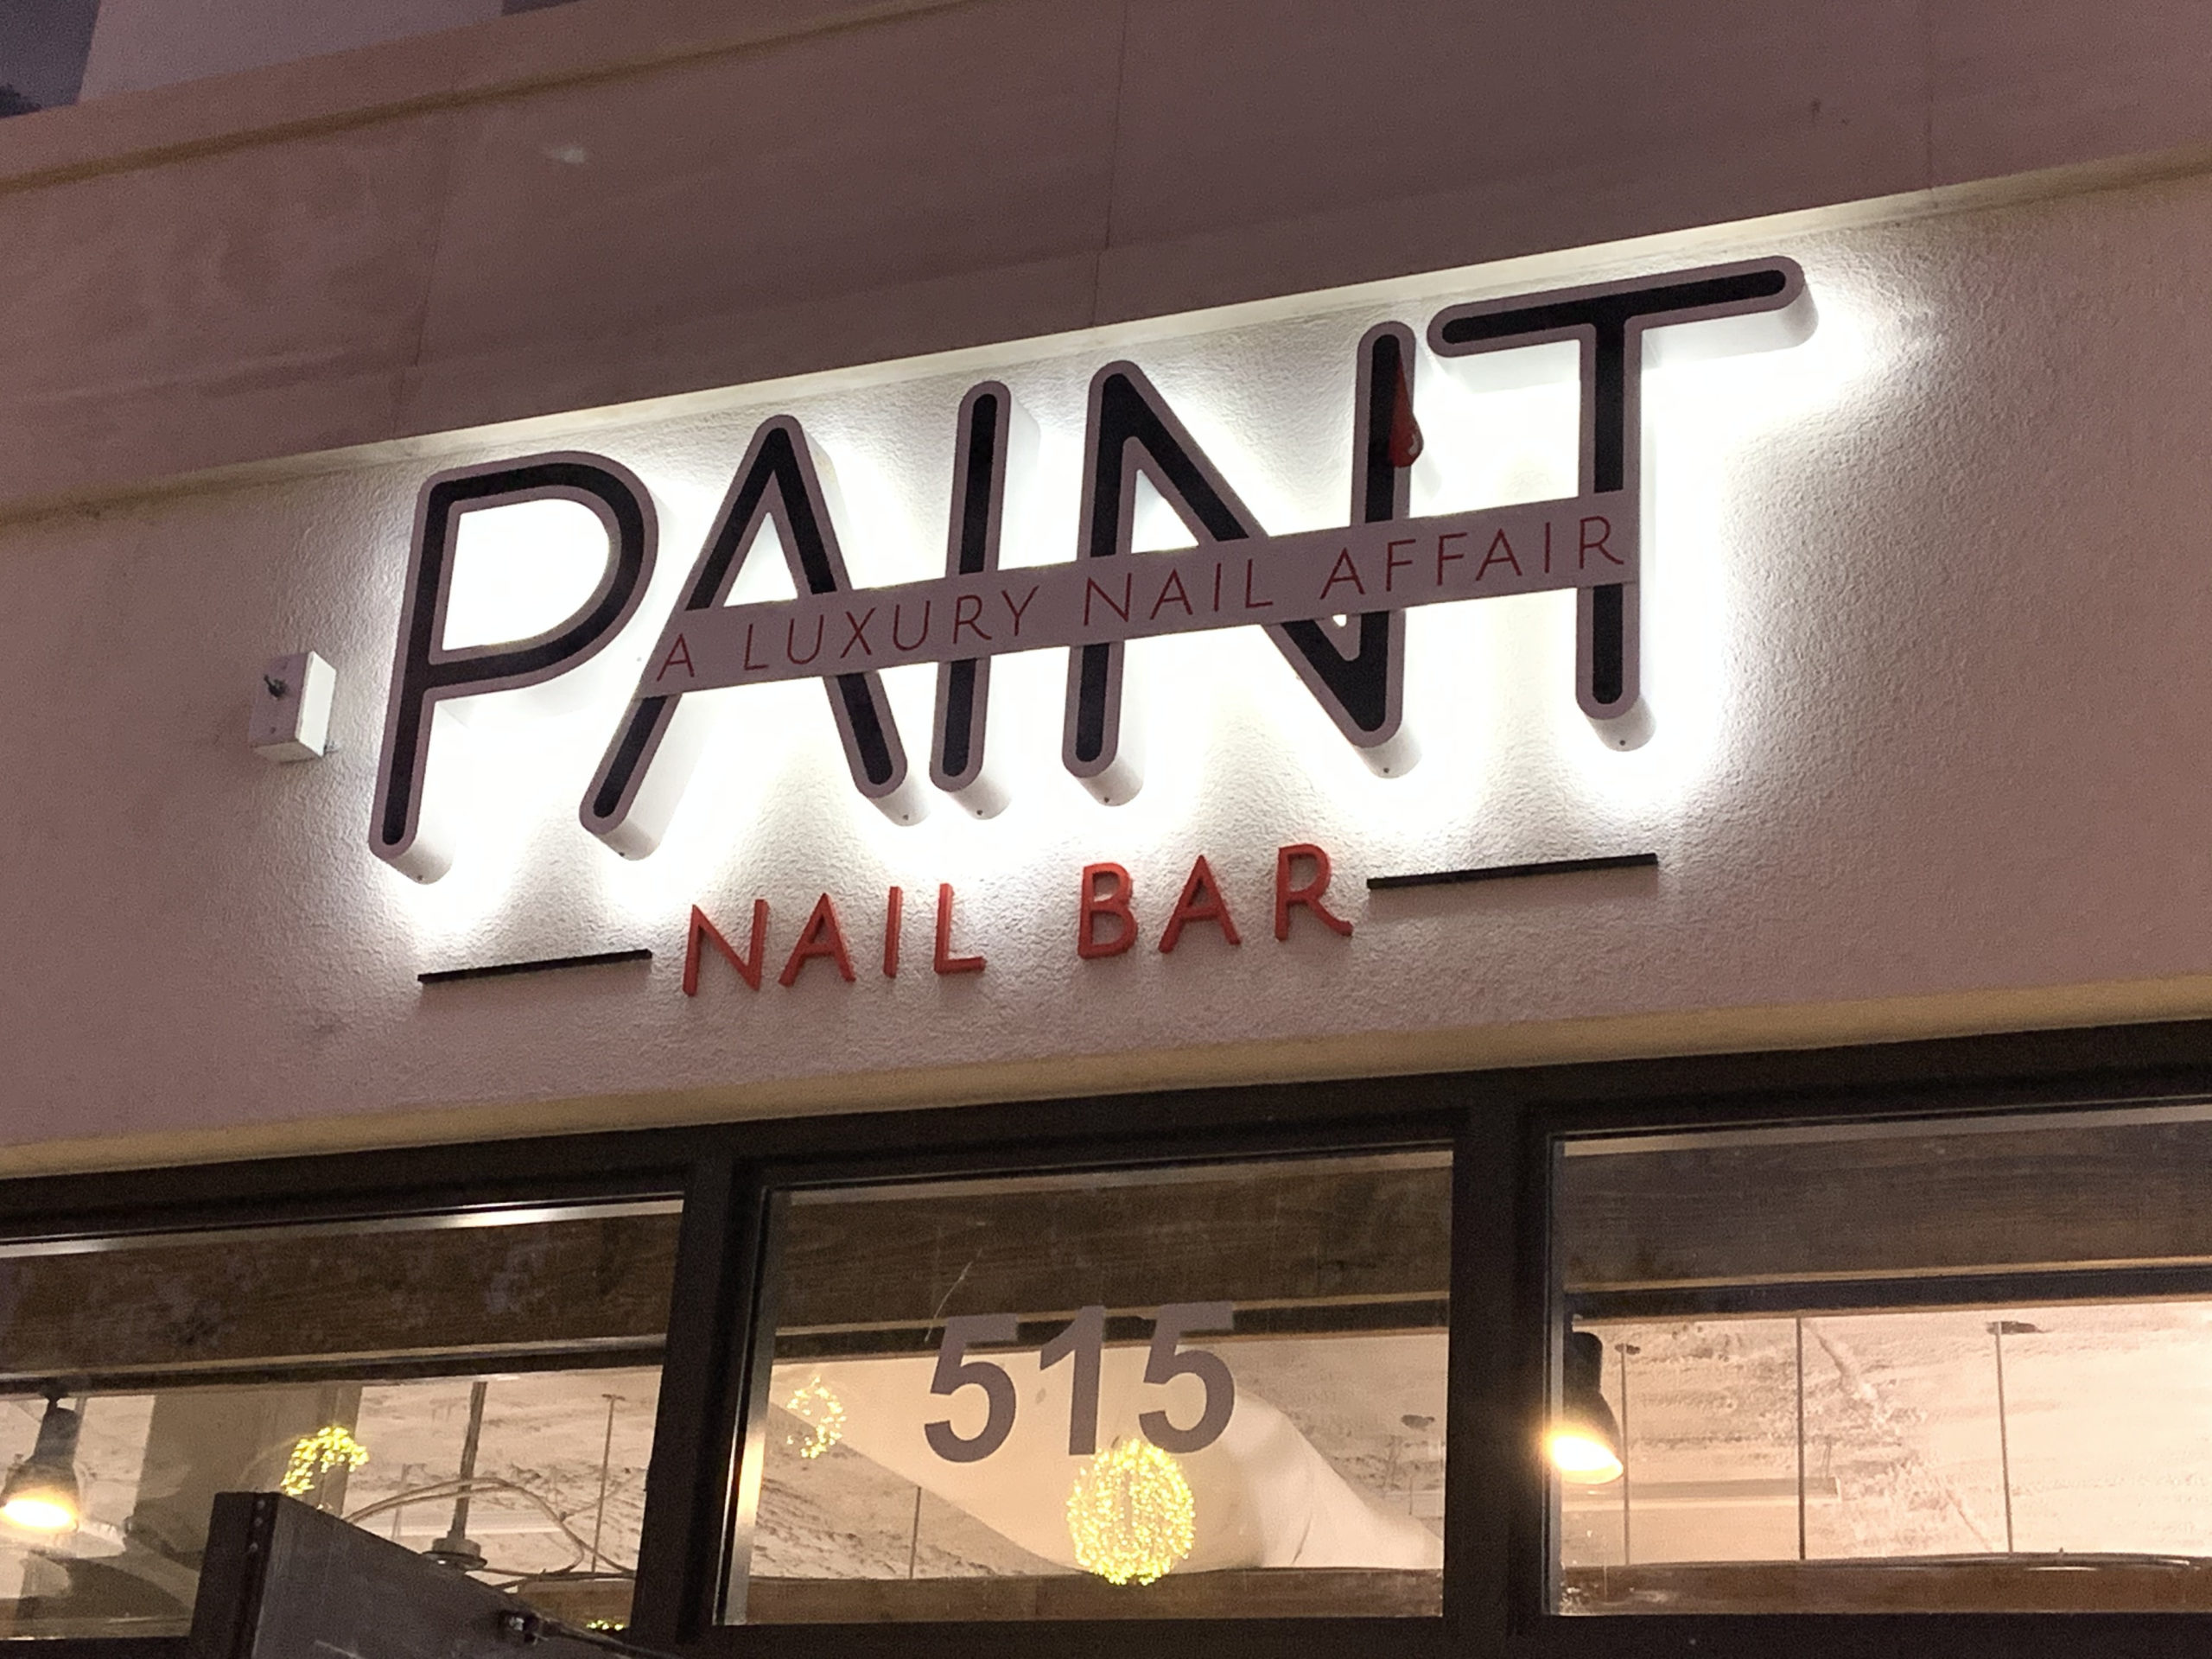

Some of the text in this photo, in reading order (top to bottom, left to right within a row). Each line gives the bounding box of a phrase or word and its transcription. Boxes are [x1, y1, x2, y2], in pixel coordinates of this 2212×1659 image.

[369, 255, 1806, 862] PAINT
[656, 515, 1624, 683] A LUXURY NAIL AFFAIR
[683, 843, 1353, 997] NAIL BAR
[924, 1301, 1236, 1464] 515
